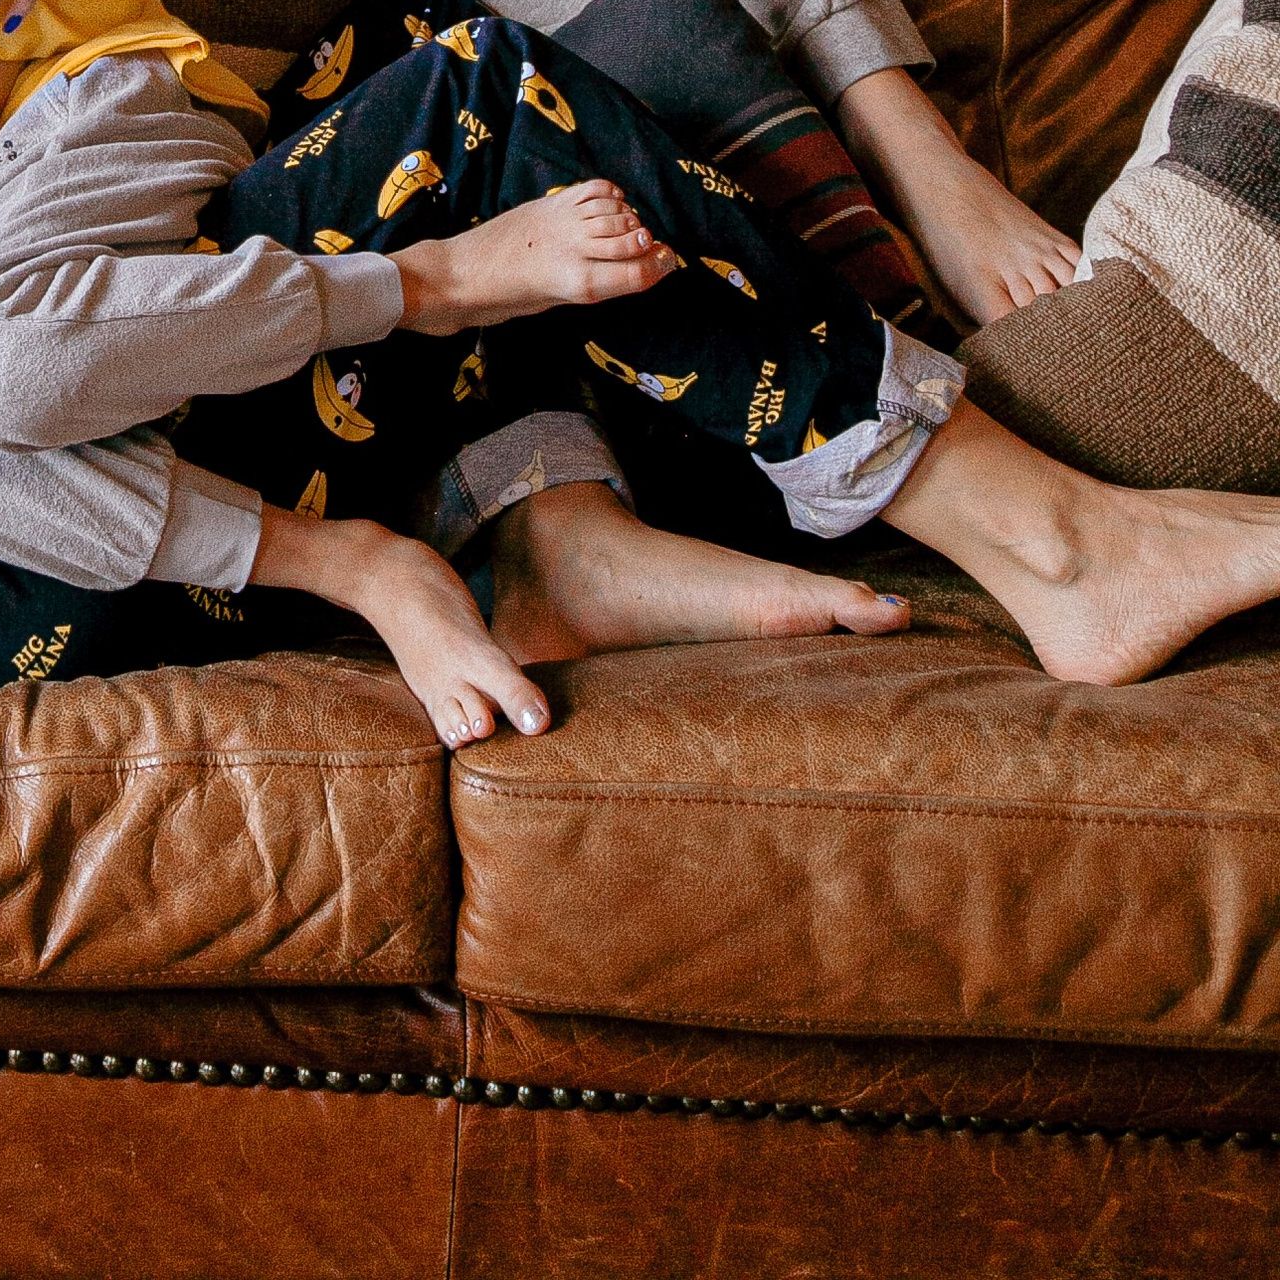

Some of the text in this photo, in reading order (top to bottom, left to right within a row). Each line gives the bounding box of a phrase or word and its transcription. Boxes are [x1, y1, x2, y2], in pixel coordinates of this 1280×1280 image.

[309, 128, 339, 157] BIG
[702, 177, 734, 199] BIG
[765, 388, 786, 425] BIG
[11, 634, 45, 673] BIG
